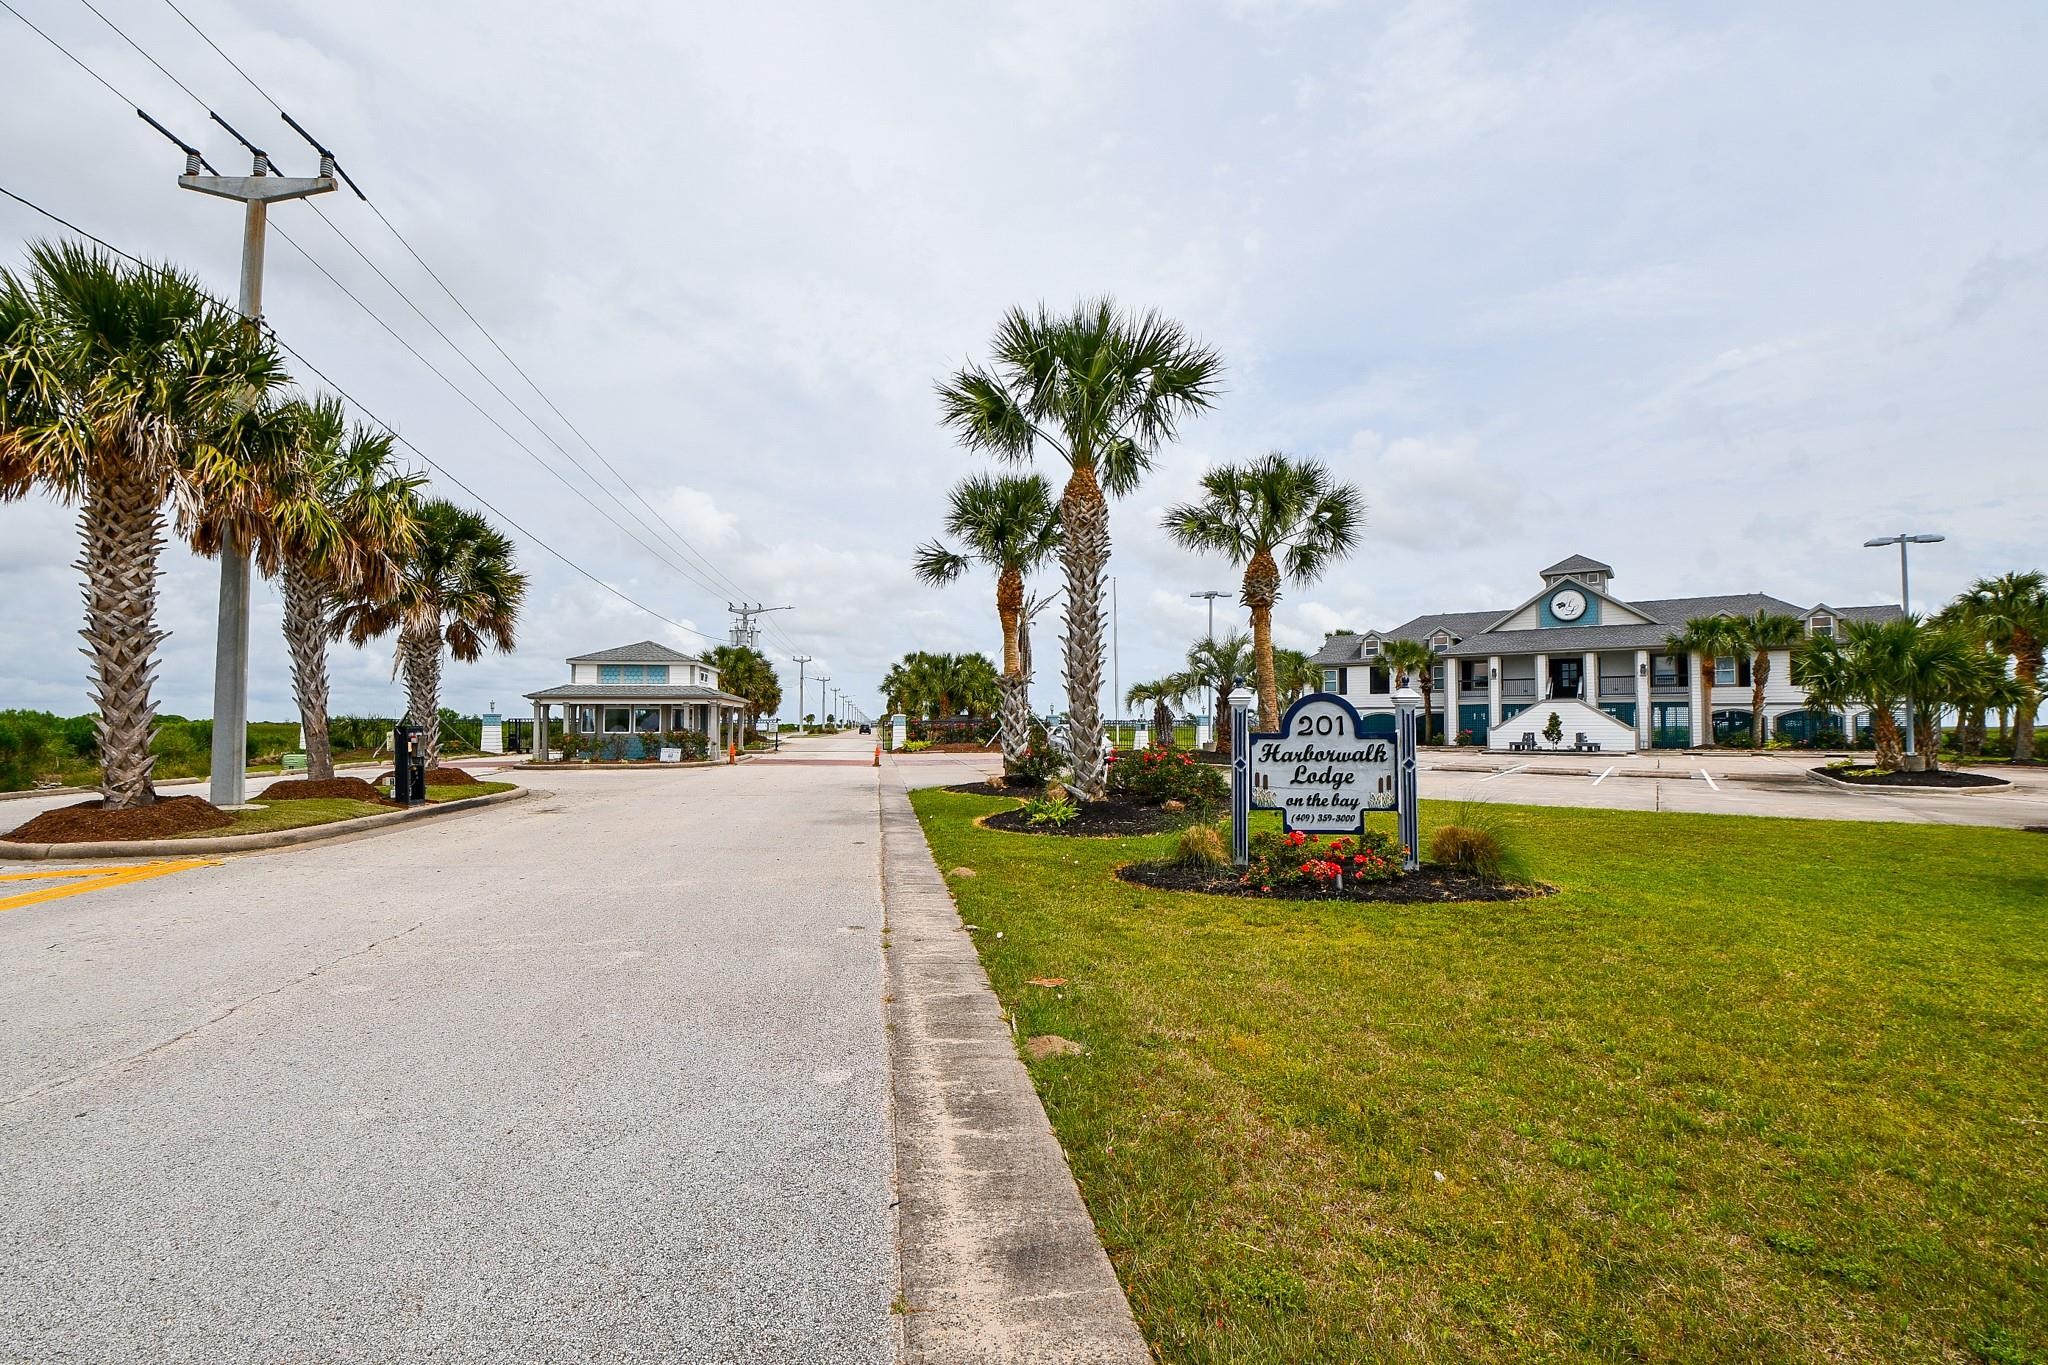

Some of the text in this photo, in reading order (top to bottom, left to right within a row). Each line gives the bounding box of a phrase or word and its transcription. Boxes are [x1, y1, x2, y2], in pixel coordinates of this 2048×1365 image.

[1297, 715, 1344, 736] 201
[1258, 743, 1387, 763] Harborwalk
[1290, 765, 1355, 789] Lodge
[1286, 793, 1360, 810] on the bay
[1291, 814, 1356, 823] (409) 359-3000
